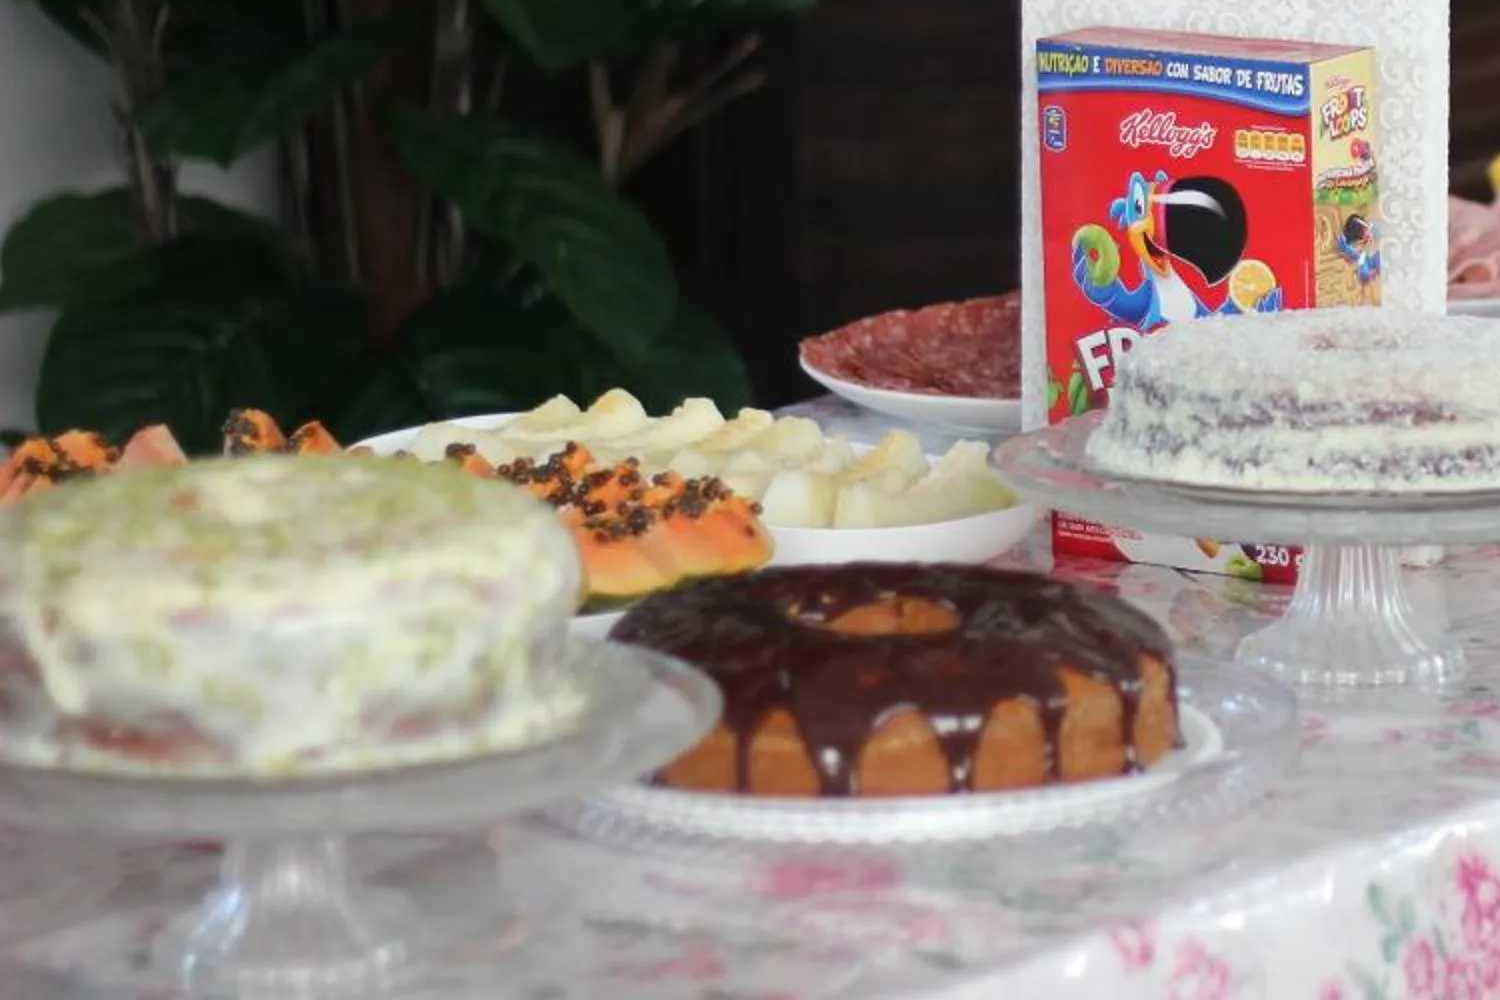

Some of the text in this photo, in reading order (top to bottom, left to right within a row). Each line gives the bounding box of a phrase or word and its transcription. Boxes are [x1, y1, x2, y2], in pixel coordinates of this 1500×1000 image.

[1093, 55, 1101, 73] E
[1193, 64, 1232, 85] SABOR
[1236, 69, 1253, 89] DE
[1257, 71, 1303, 96] FRUTAS
[1119, 108, 1218, 159] Kellogg's
[1256, 545, 1290, 567] 230
